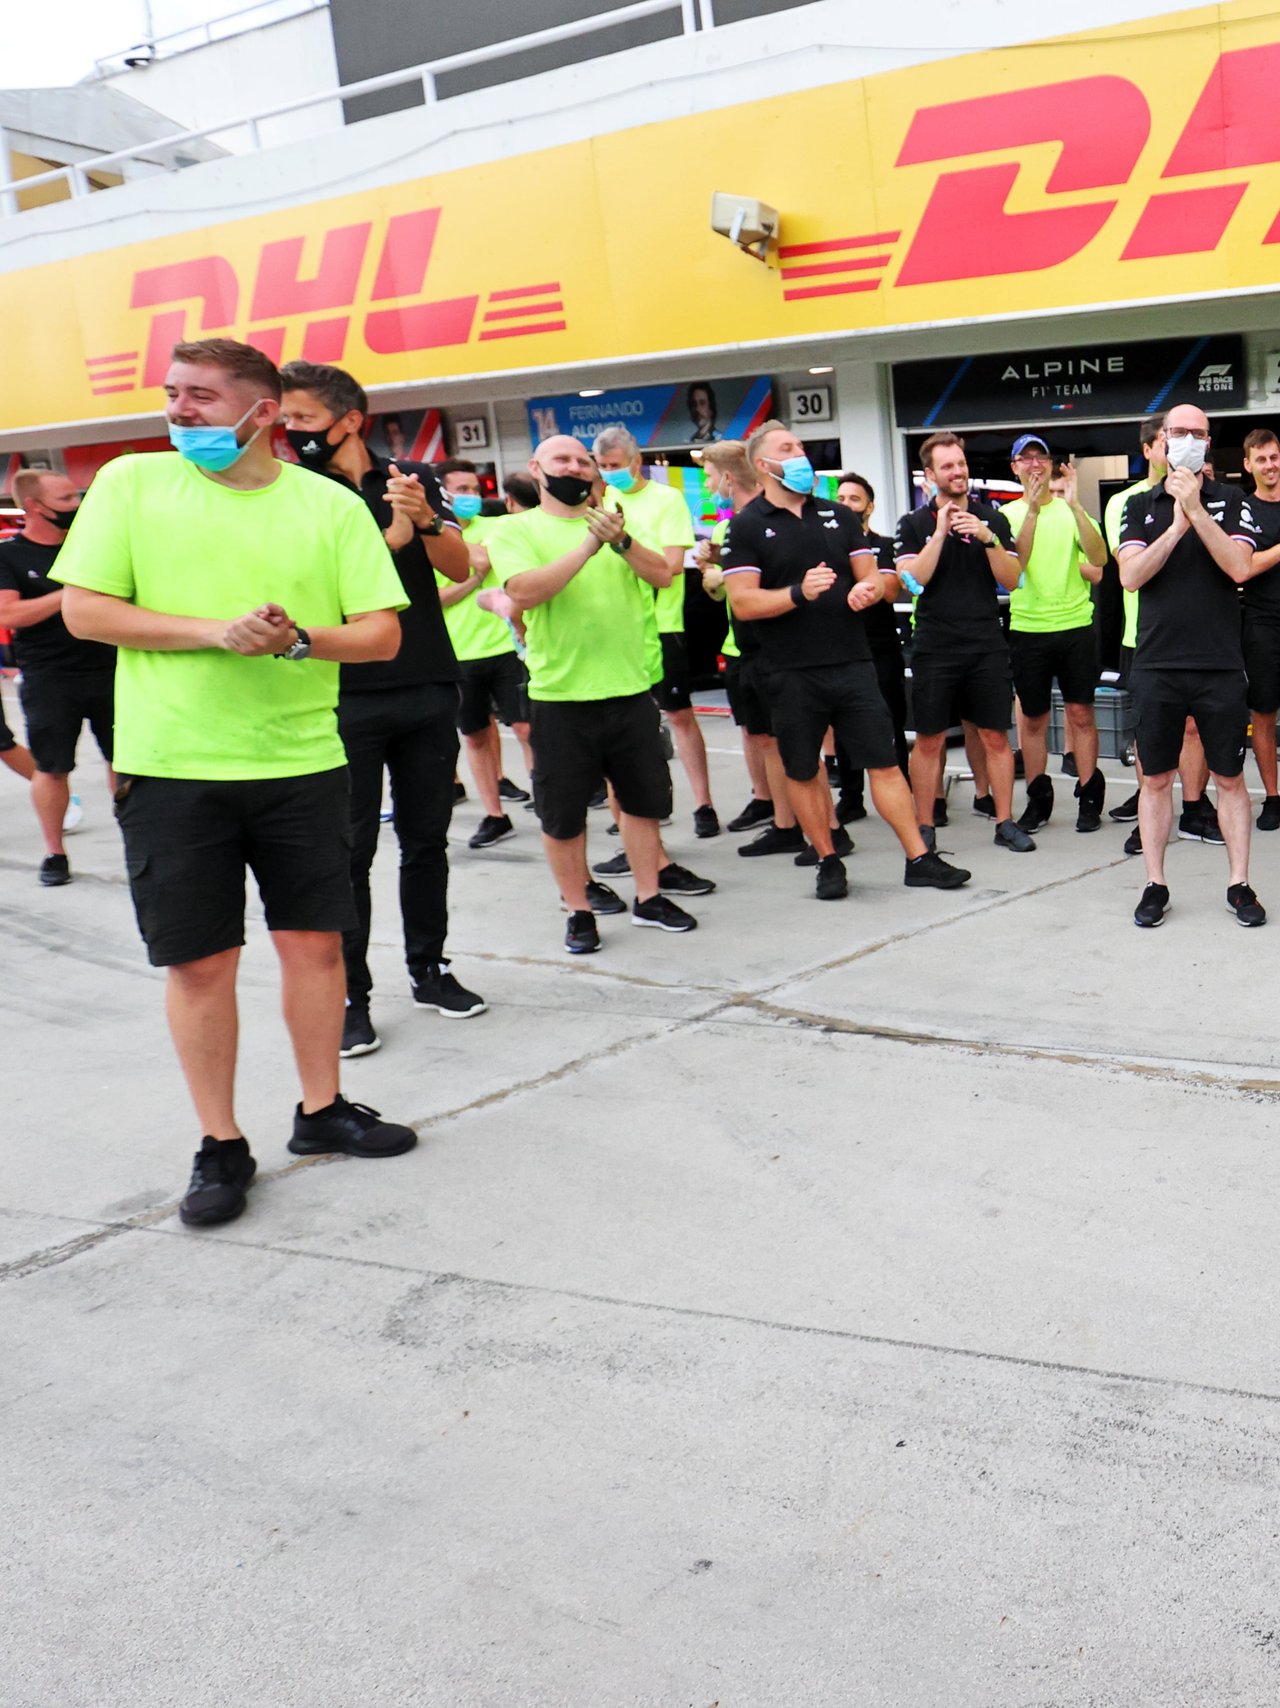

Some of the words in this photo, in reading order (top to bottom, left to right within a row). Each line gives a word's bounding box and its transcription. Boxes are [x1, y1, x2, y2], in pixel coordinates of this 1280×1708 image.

[130, 207, 479, 389] DHL
[1001, 356, 1124, 380] ALPINE
[1055, 383, 1092, 396] TEAM
[1198, 383, 1212, 392] AS
[1213, 382, 1233, 391] ONE
[569, 399, 644, 420] FERNANDO
[797, 394, 822, 416] 30
[462, 425, 480, 442] 31
[531, 407, 560, 441] 14
[571, 420, 626, 439] ALO
